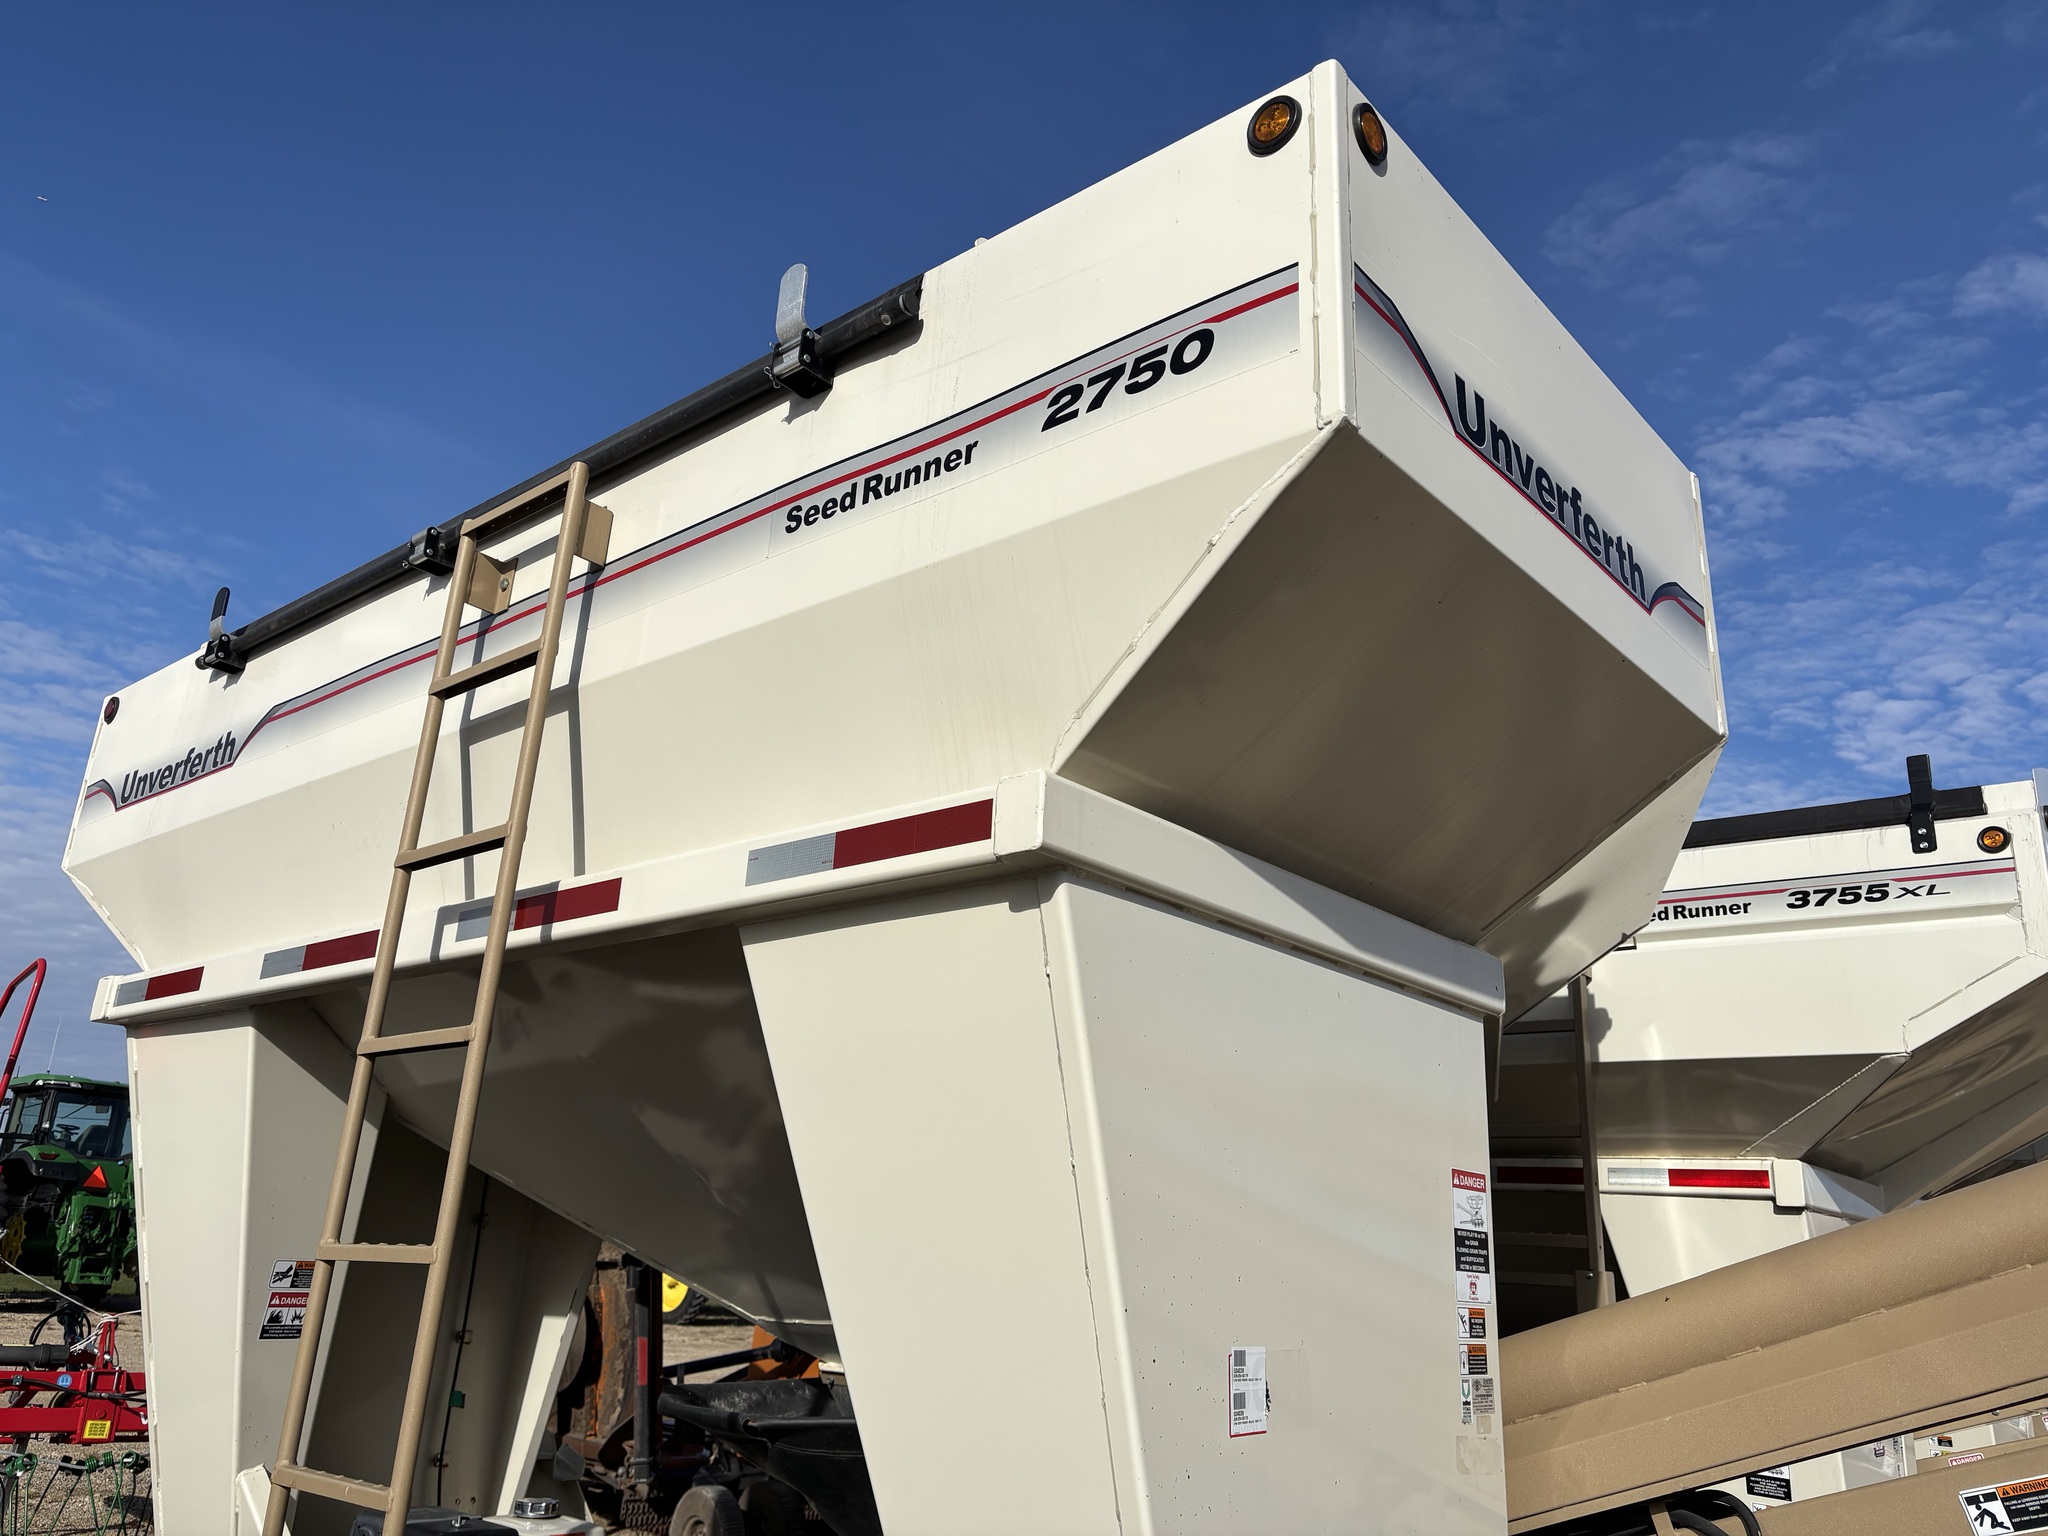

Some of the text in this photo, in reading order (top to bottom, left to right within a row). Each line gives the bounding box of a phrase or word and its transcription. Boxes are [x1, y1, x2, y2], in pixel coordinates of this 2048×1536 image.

[1040, 328, 1215, 433] 2750
[784, 440, 979, 535] Seed Runner
[1454, 371, 1648, 604] Unverferth
[120, 731, 237, 804] Unverferth
[1673, 902, 1752, 920] Runner
[1786, 883, 1951, 909] 3755 XL
[1460, 1175, 1485, 1189] DANGER
[1956, 1456, 1982, 1464] DANGER
